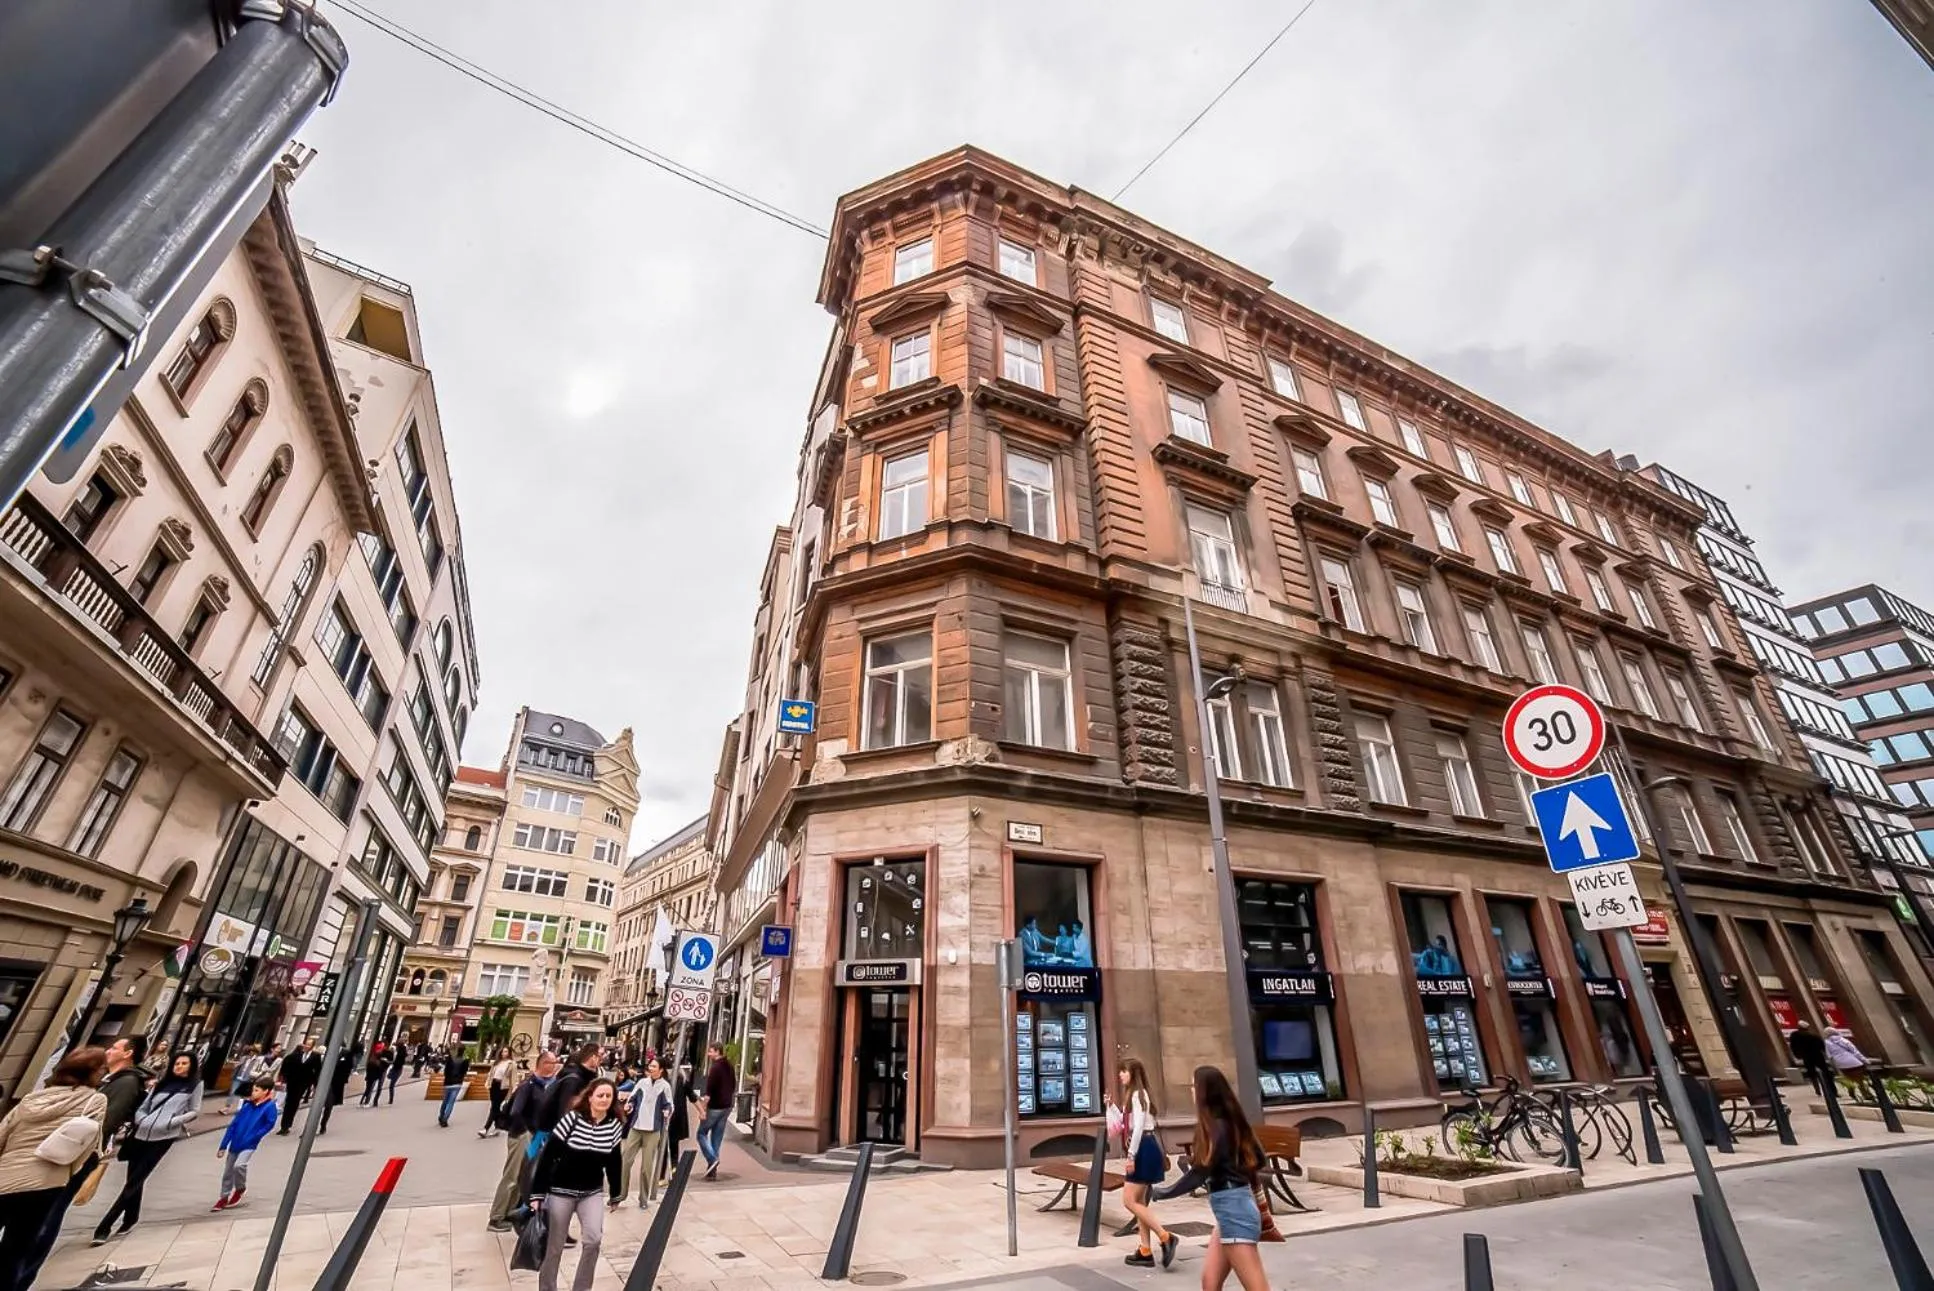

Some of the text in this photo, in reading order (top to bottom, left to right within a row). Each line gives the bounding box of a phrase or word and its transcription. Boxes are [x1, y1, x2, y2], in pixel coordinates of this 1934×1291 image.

[1528, 710, 1577, 751] 30
[1575, 870, 1629, 892] KIVÉVE
[1043, 972, 1088, 988] tower
[1262, 978, 1316, 990] INGATLAN
[1416, 980, 1467, 991] REAL ESTATE
[316, 979, 336, 1011] ZARA
